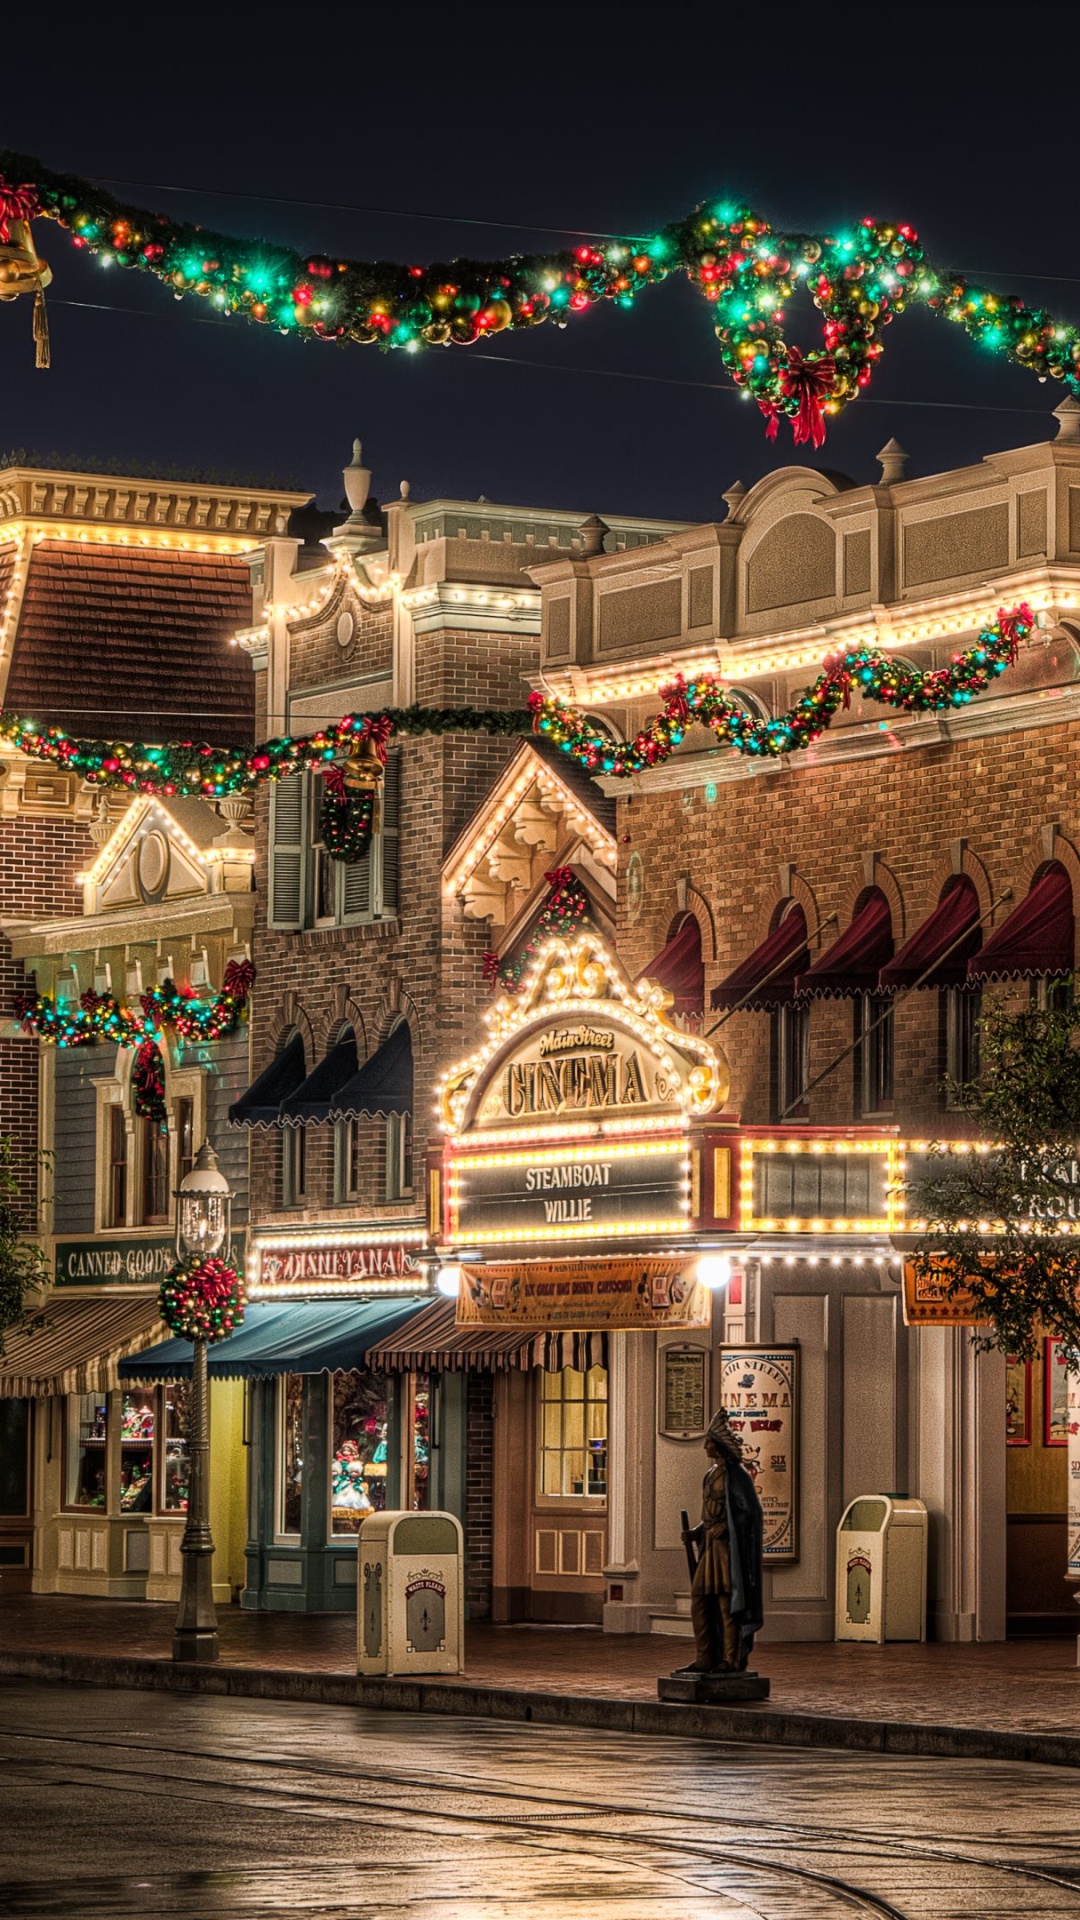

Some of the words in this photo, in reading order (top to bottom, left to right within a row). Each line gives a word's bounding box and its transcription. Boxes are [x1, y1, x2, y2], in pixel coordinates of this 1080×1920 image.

[540, 1029, 576, 1056] Main
[574, 1024, 614, 1050] Street
[502, 1050, 649, 1116] CINEMA
[525, 1163, 612, 1191] STEAMBOAT
[543, 1198, 592, 1223] WILLIE
[68, 1252, 121, 1277] CANNED
[284, 1248, 398, 1281] DISNEYANA
[744, 1361, 786, 1386] STREET
[721, 1393, 791, 1407] INEMA
[771, 1455, 786, 1465] SIX
